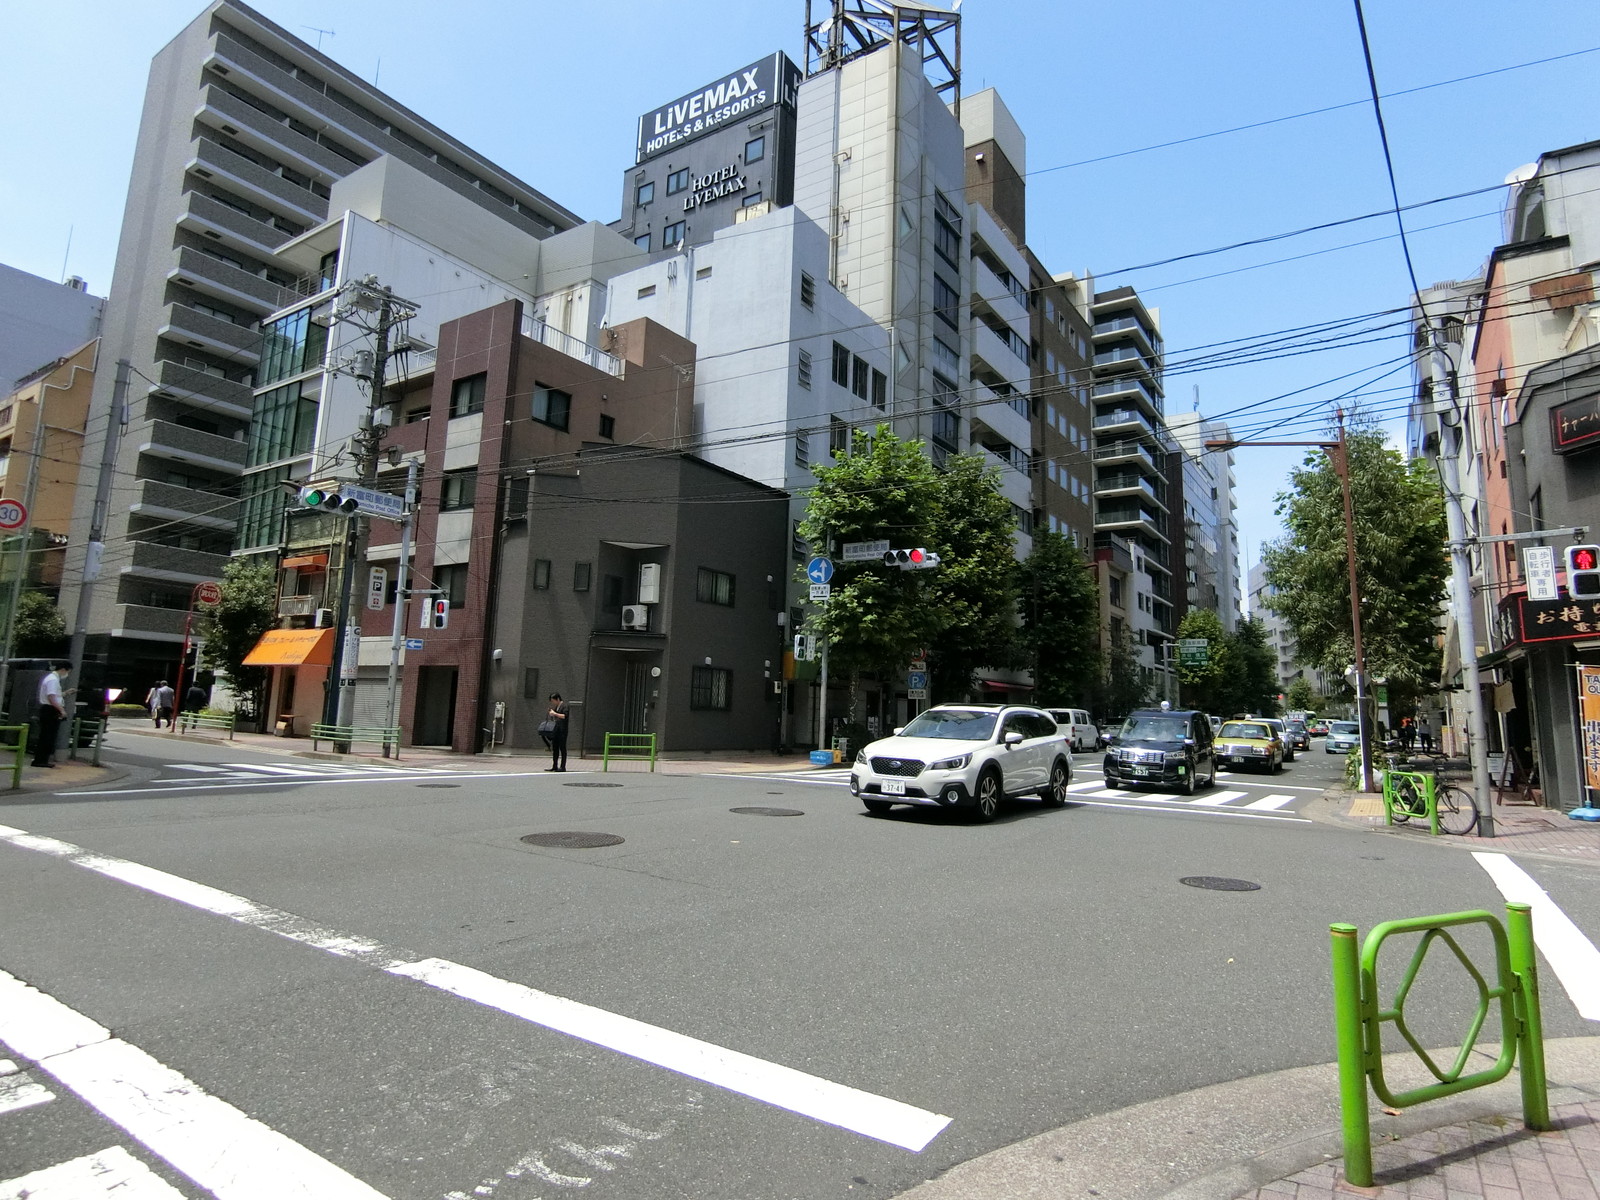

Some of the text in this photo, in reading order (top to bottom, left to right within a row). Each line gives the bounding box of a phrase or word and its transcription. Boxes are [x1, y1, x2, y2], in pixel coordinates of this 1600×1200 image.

[654, 67, 759, 135] LiVEMAX
[646, 126, 691, 153] HOTELS
[693, 120, 704, 133] &
[705, 90, 766, 131] RESORTS
[692, 164, 738, 193] HOTEL
[682, 175, 747, 211] LiVEMAX
[0, 506, 19, 522] 30
[1529, 552, 1540, 578] 自転車
[1539, 552, 1550, 578] 歩行者
[374, 582, 381, 590] P
[1536, 579, 1548, 596] 専用
[912, 676, 919, 688] P
[887, 784, 902, 792] 37-41
